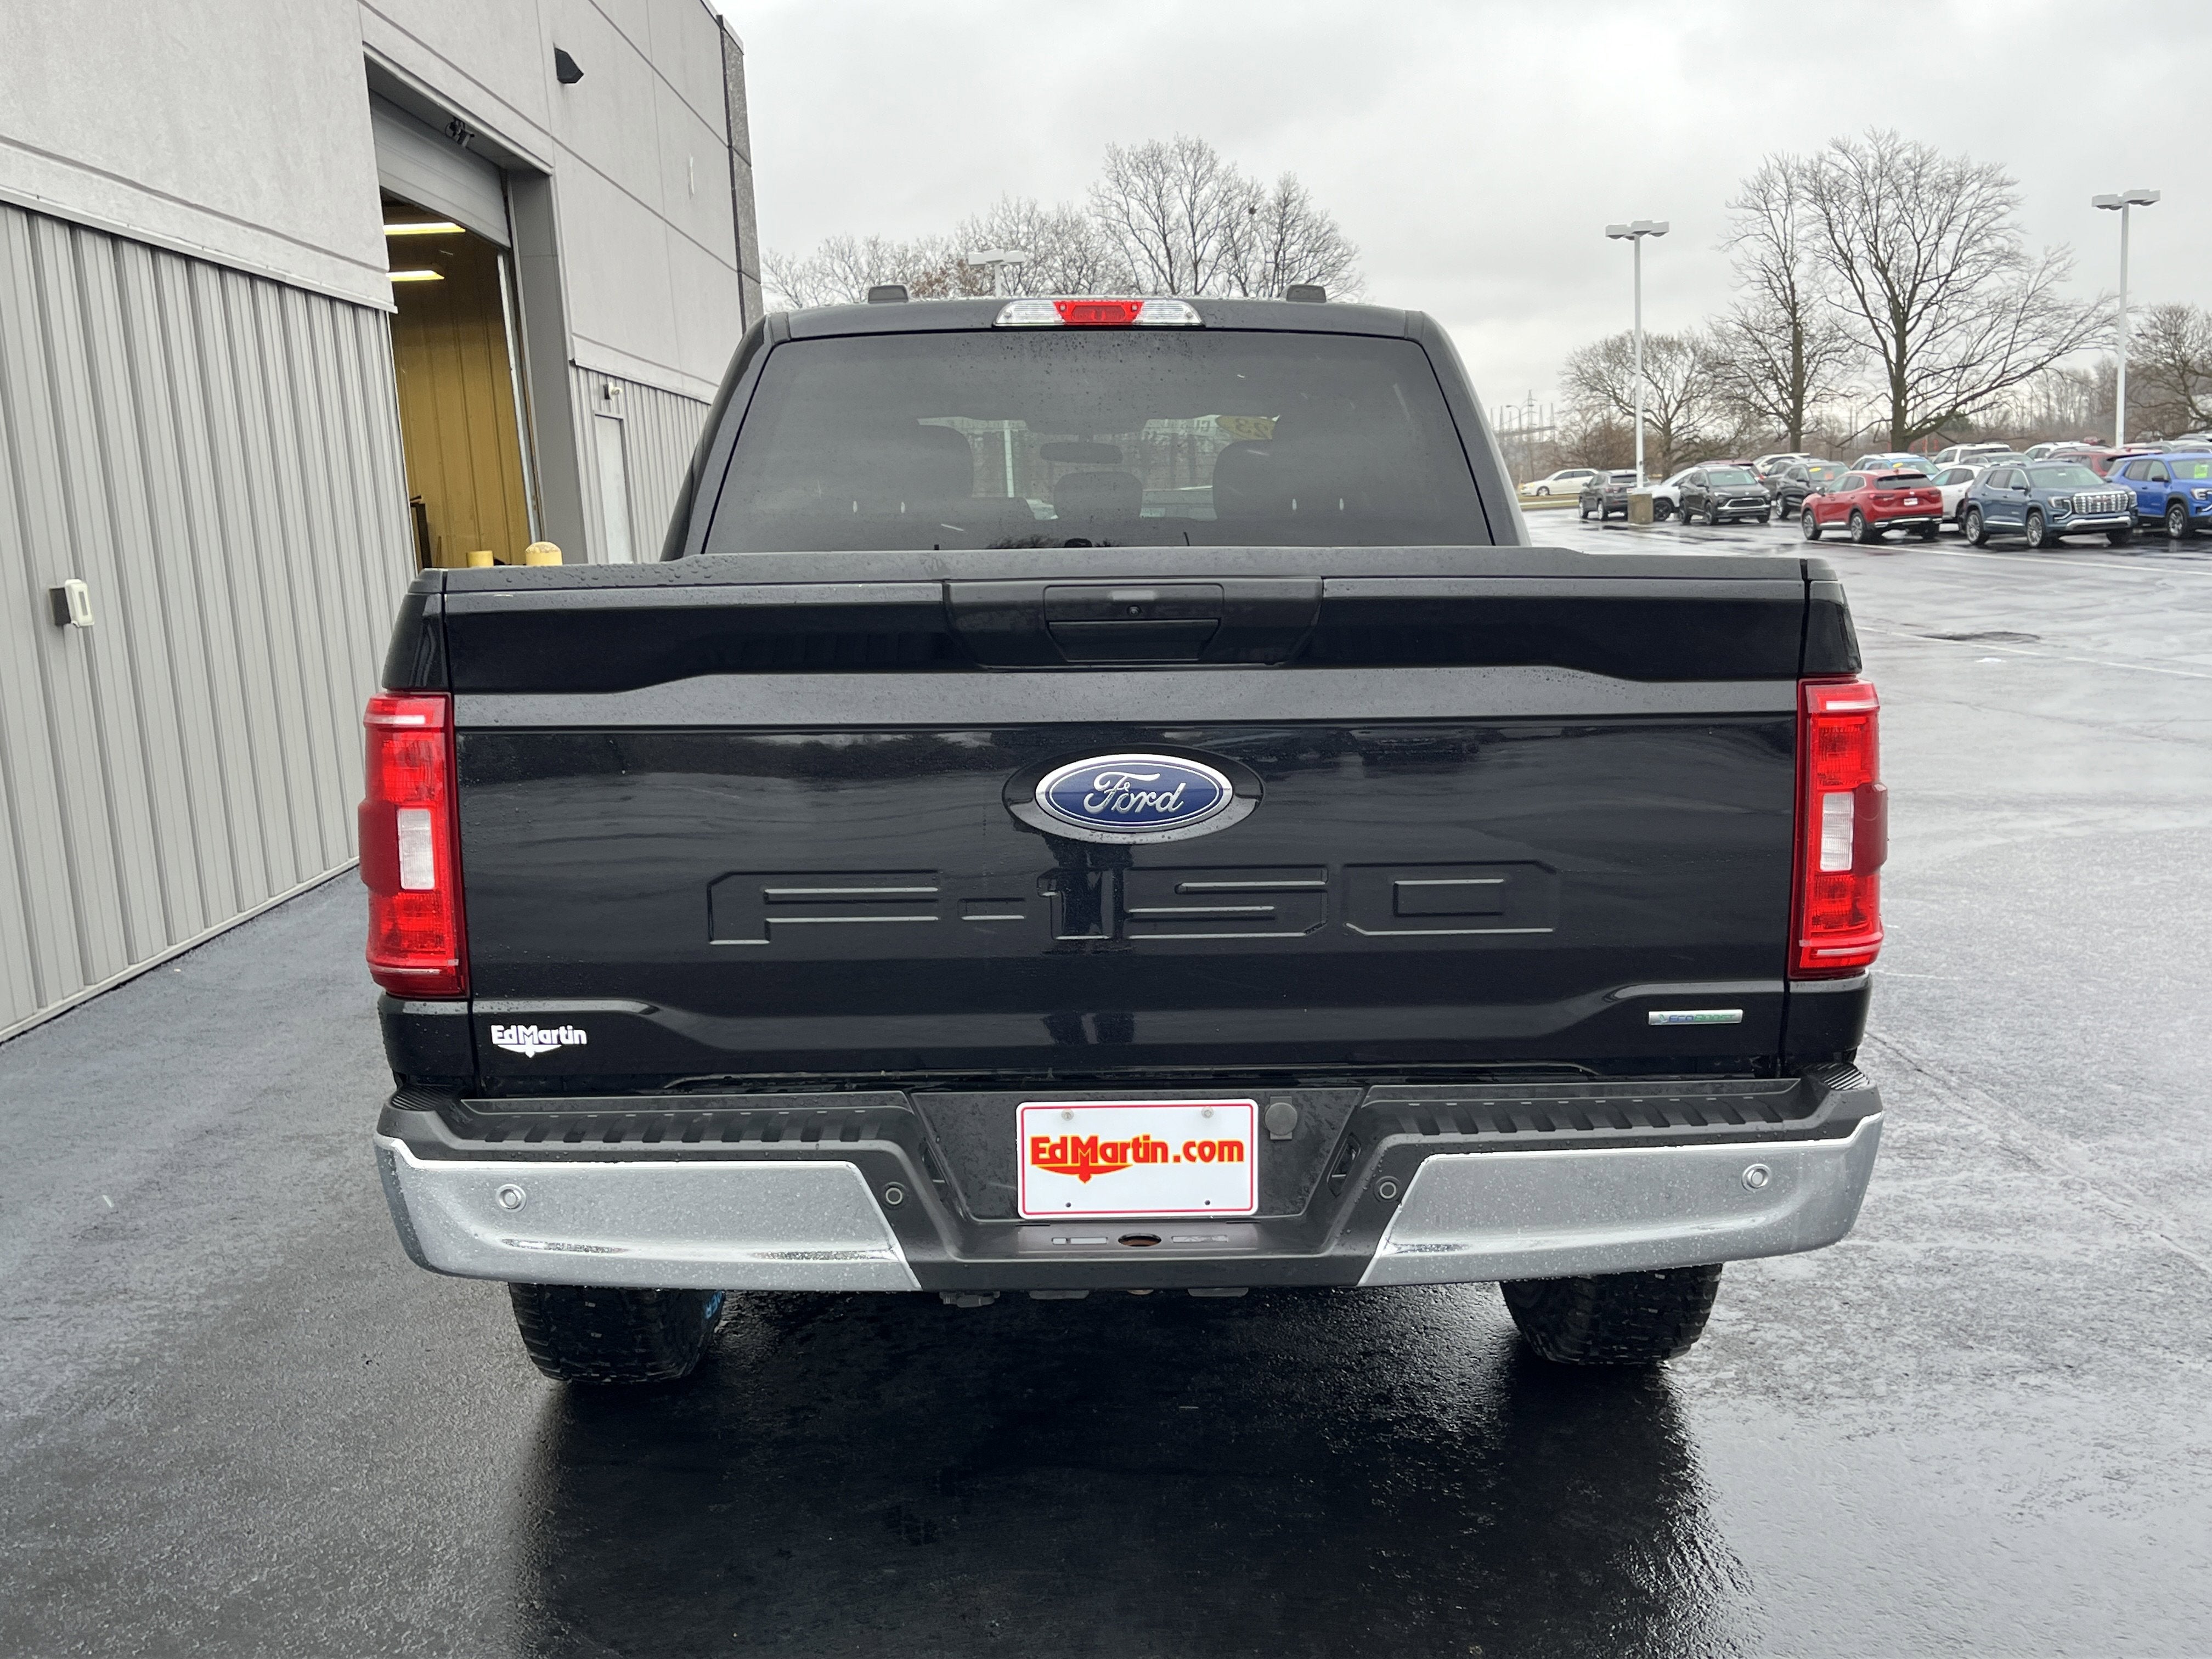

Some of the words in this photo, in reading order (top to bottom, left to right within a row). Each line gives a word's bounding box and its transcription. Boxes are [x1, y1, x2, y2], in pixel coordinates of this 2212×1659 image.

[1084, 771, 1186, 814] Ford
[707, 860, 1559, 944] F-150
[490, 1025, 587, 1045] EdMartin
[1030, 1133, 1245, 1166] EdMartin.com
